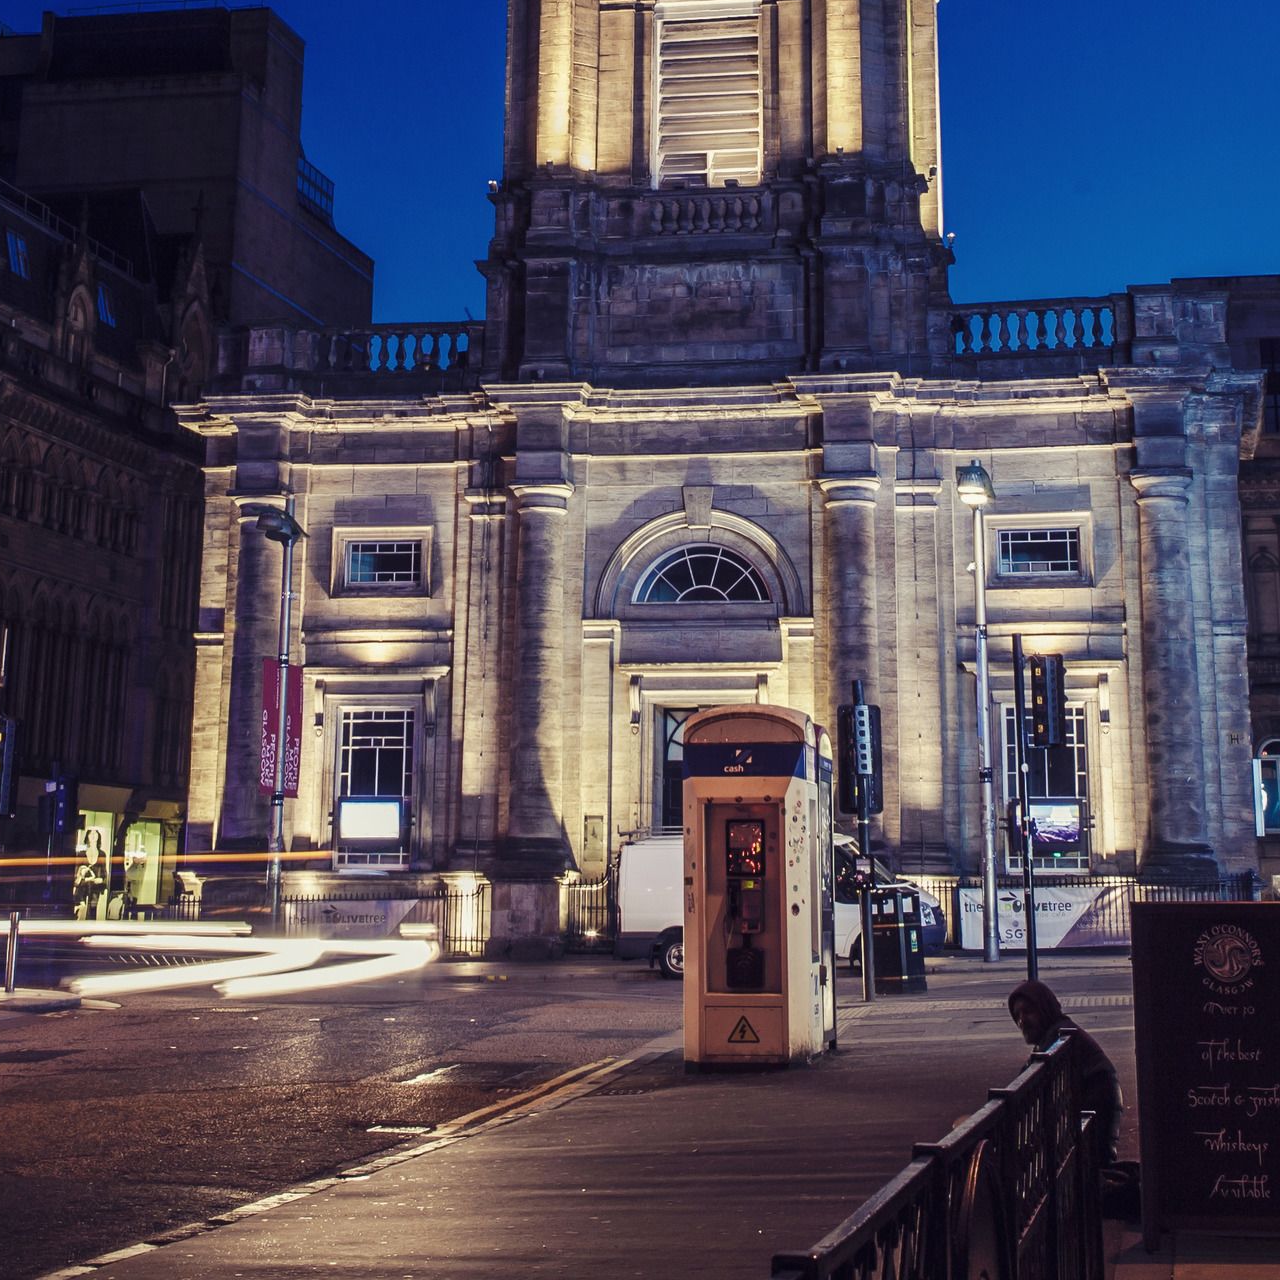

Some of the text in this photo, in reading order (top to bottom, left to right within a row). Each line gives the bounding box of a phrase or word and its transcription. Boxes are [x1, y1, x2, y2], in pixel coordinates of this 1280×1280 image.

[260, 709, 268, 787] GLASGOW
[268, 733, 276, 787] PEOPLE
[284, 714, 292, 789] GLASGOW
[292, 737, 300, 790] PEOPLE
[724, 764, 744, 773] cash
[1005, 928, 1026, 939] SG
[1193, 930, 1211, 966] WAXY
[1202, 977, 1255, 995] GLASGOW
[1237, 1038, 1261, 1061] best
[1187, 1083, 1231, 1108] Scotch
[1194, 1128, 1269, 1167] Whiskeys
[1209, 1174, 1271, 1200] Available
